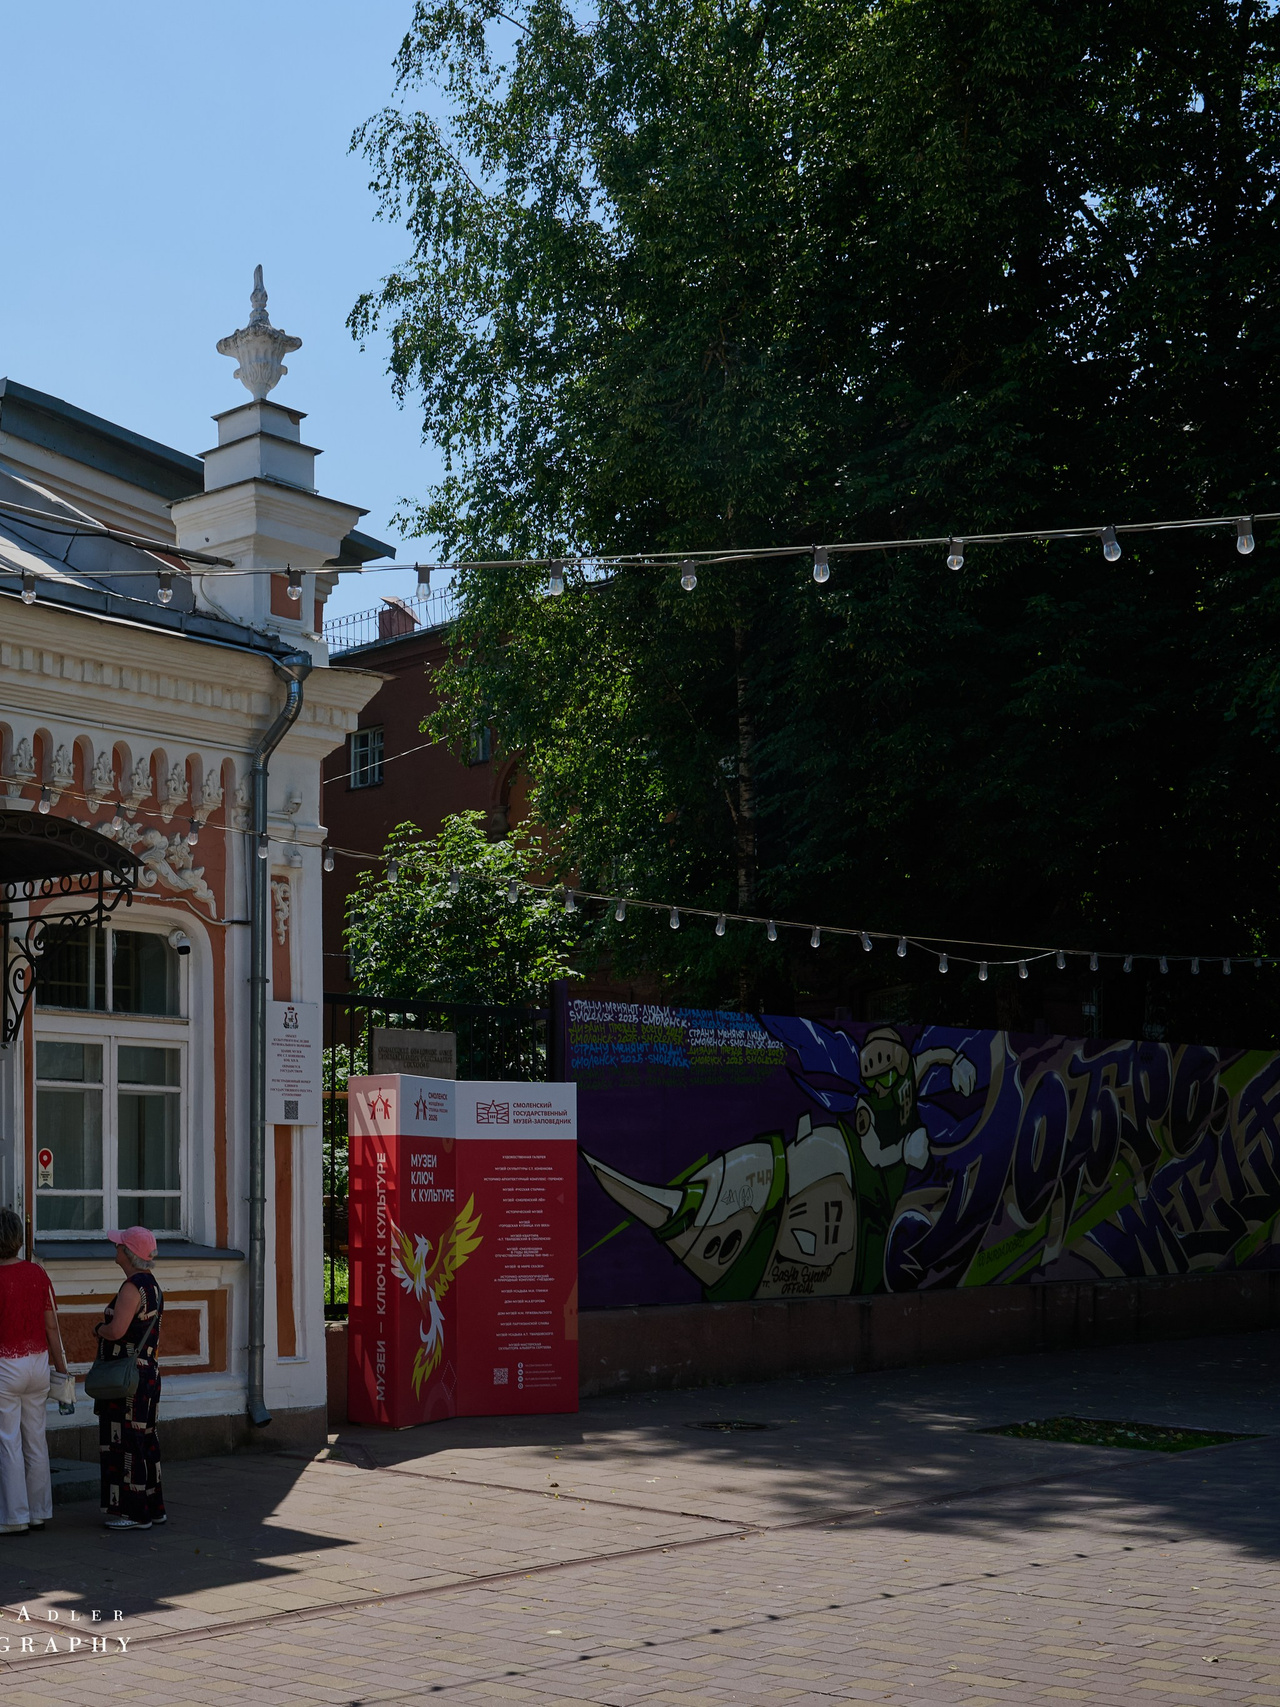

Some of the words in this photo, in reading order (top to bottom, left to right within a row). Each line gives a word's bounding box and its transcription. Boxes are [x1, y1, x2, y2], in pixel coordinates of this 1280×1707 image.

[618, 1014, 639, 1024] 2025
[512, 1101, 552, 1109] СМОЛЕНСКИЙ
[512, 1109, 568, 1117] ГОСУДАРСТВЕННЫЙ
[512, 1117, 572, 1125] МУЗЕЙ-ЗАПОВЕДНИК
[410, 1153, 438, 1168] МУЗЕИ
[410, 1171, 434, 1185] КЛЮЧ
[376, 1152, 386, 1239] КУЛЬТУРЕ
[411, 1188, 417, 1203] К
[419, 1188, 455, 1203] КУЛЬТУРЕ
[376, 1246, 386, 1256] К
[376, 1263, 386, 1315] КЛЮЧ
[376, 1340, 386, 1401] МУЗЕИ
